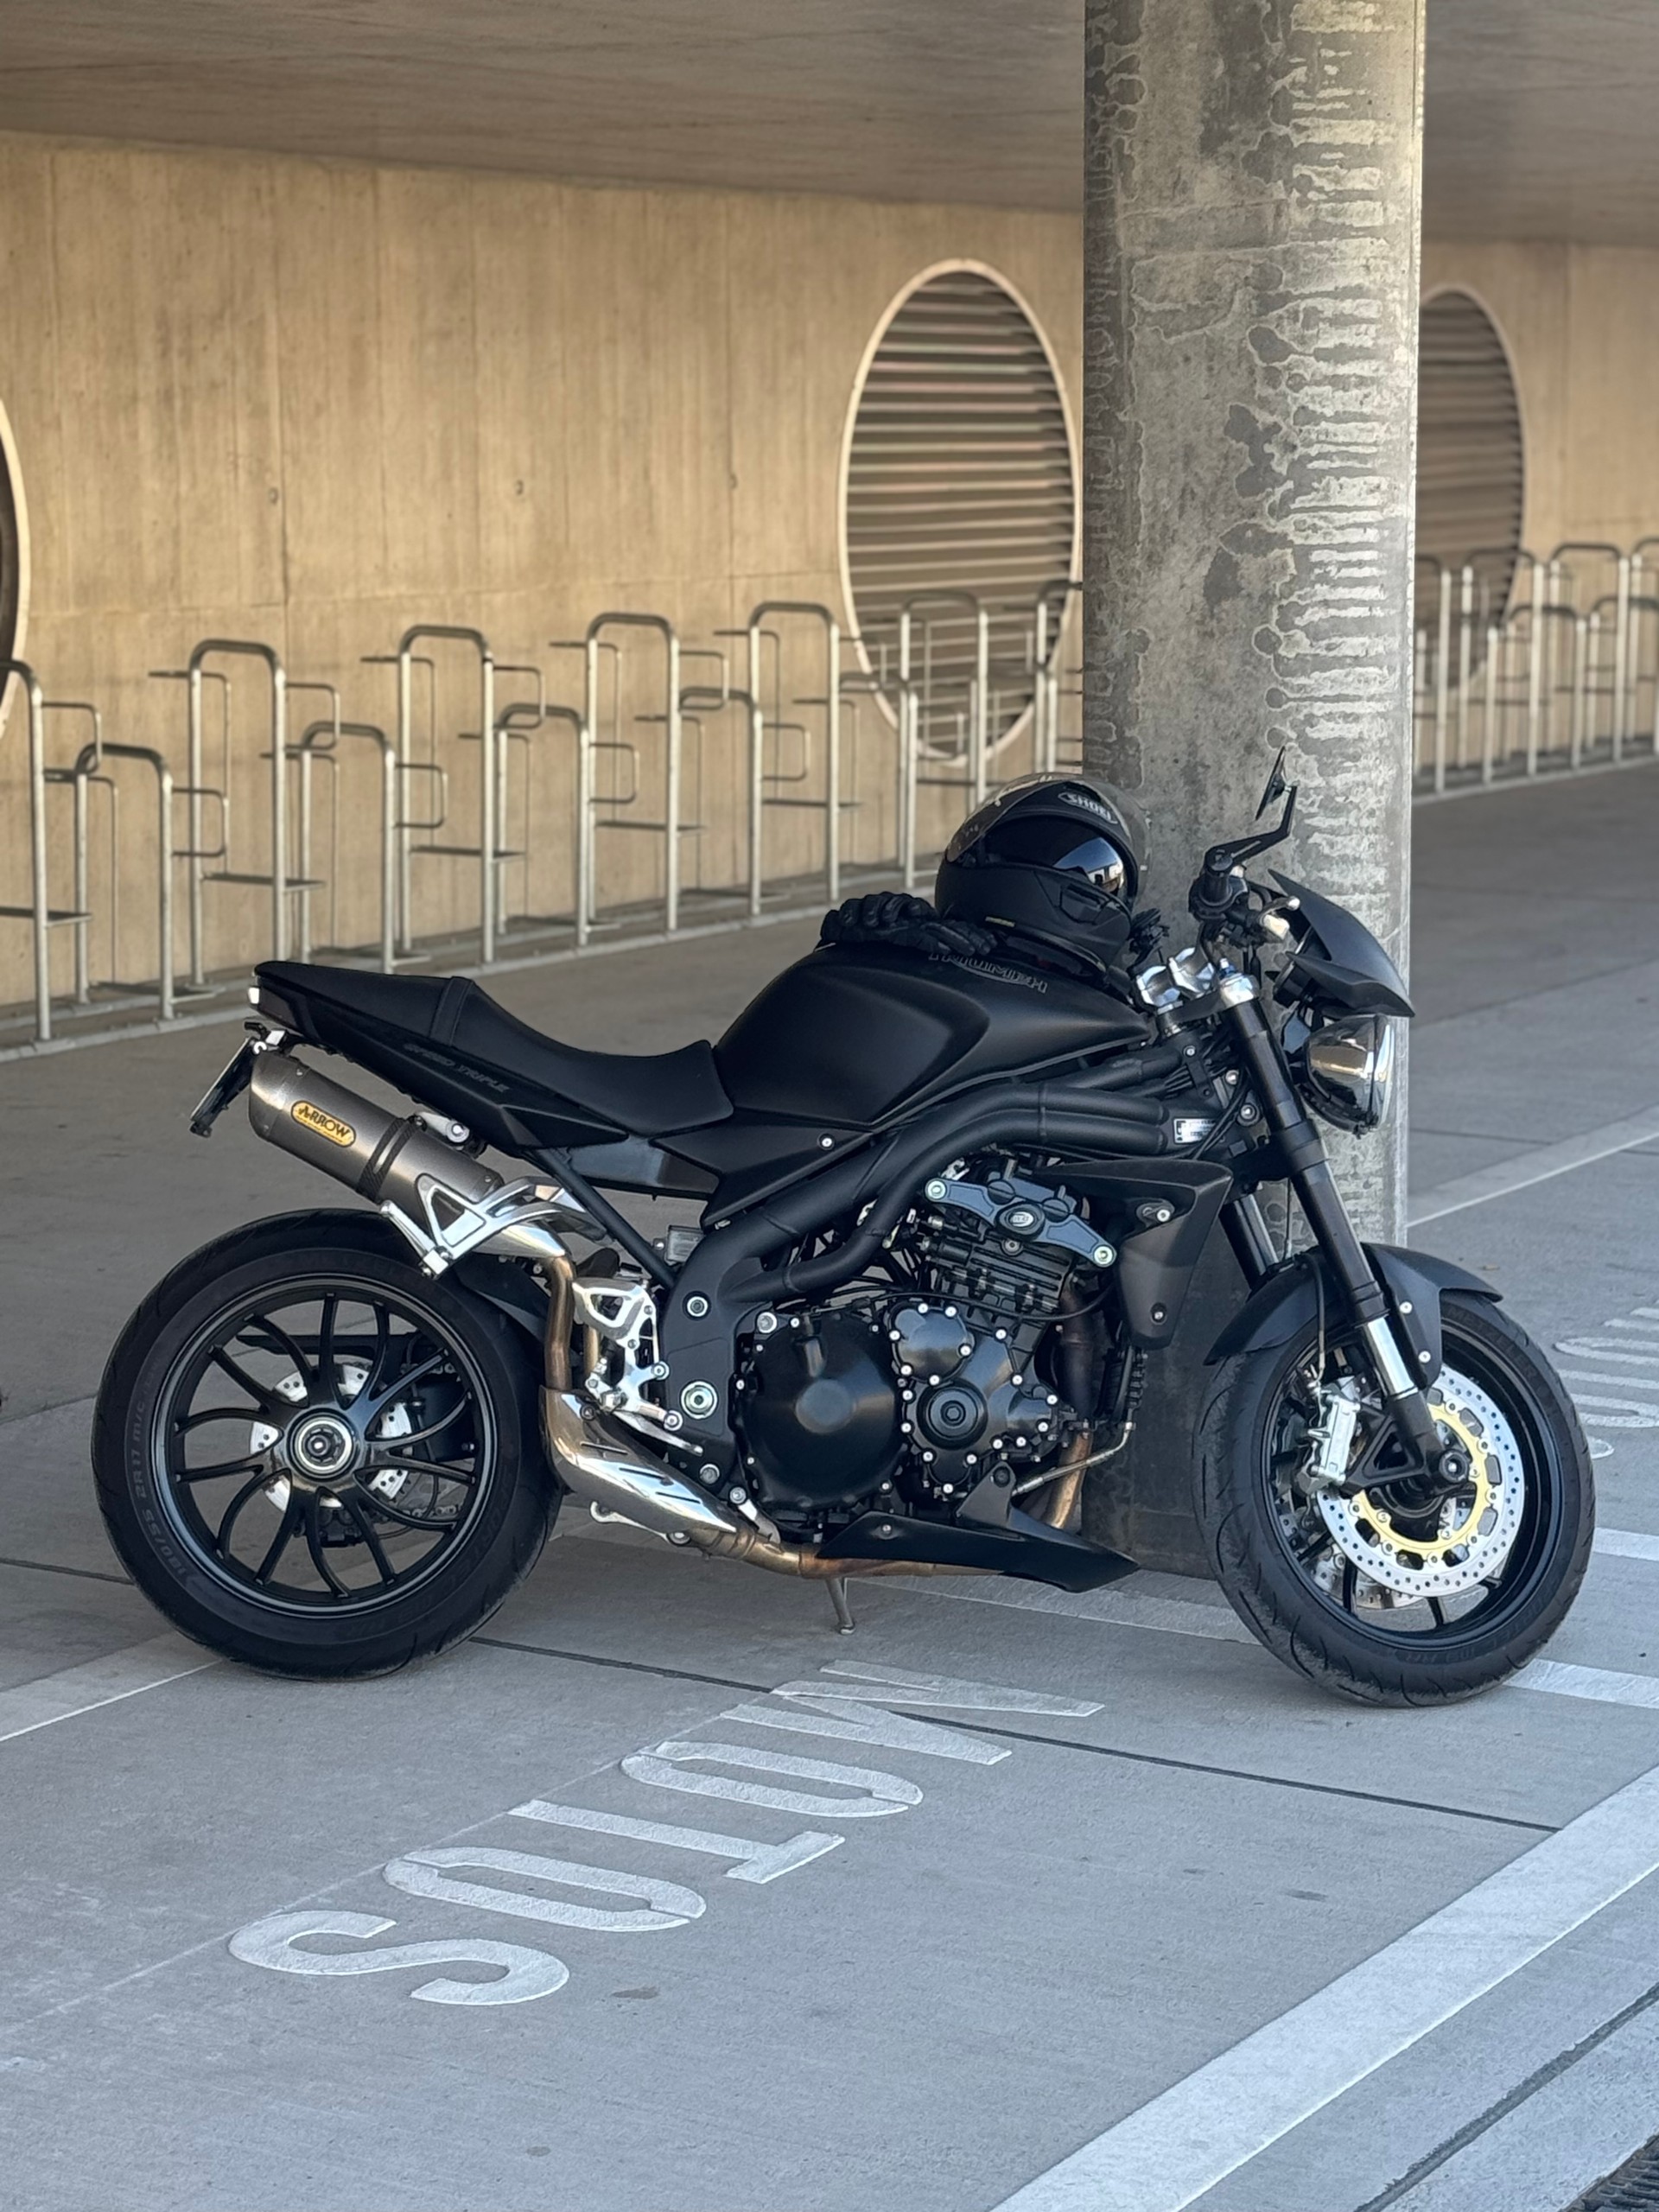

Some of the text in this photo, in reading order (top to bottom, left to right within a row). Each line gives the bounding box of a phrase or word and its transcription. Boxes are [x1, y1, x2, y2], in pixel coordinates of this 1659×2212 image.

[1063, 792, 1115, 823] SHOEI
[458, 1065, 512, 1093] TRIPLE
[298, 1106, 351, 1138] ARROW
[141, 1507, 187, 1575] 180/55
[227, 1660, 1104, 2005] MOTOS
